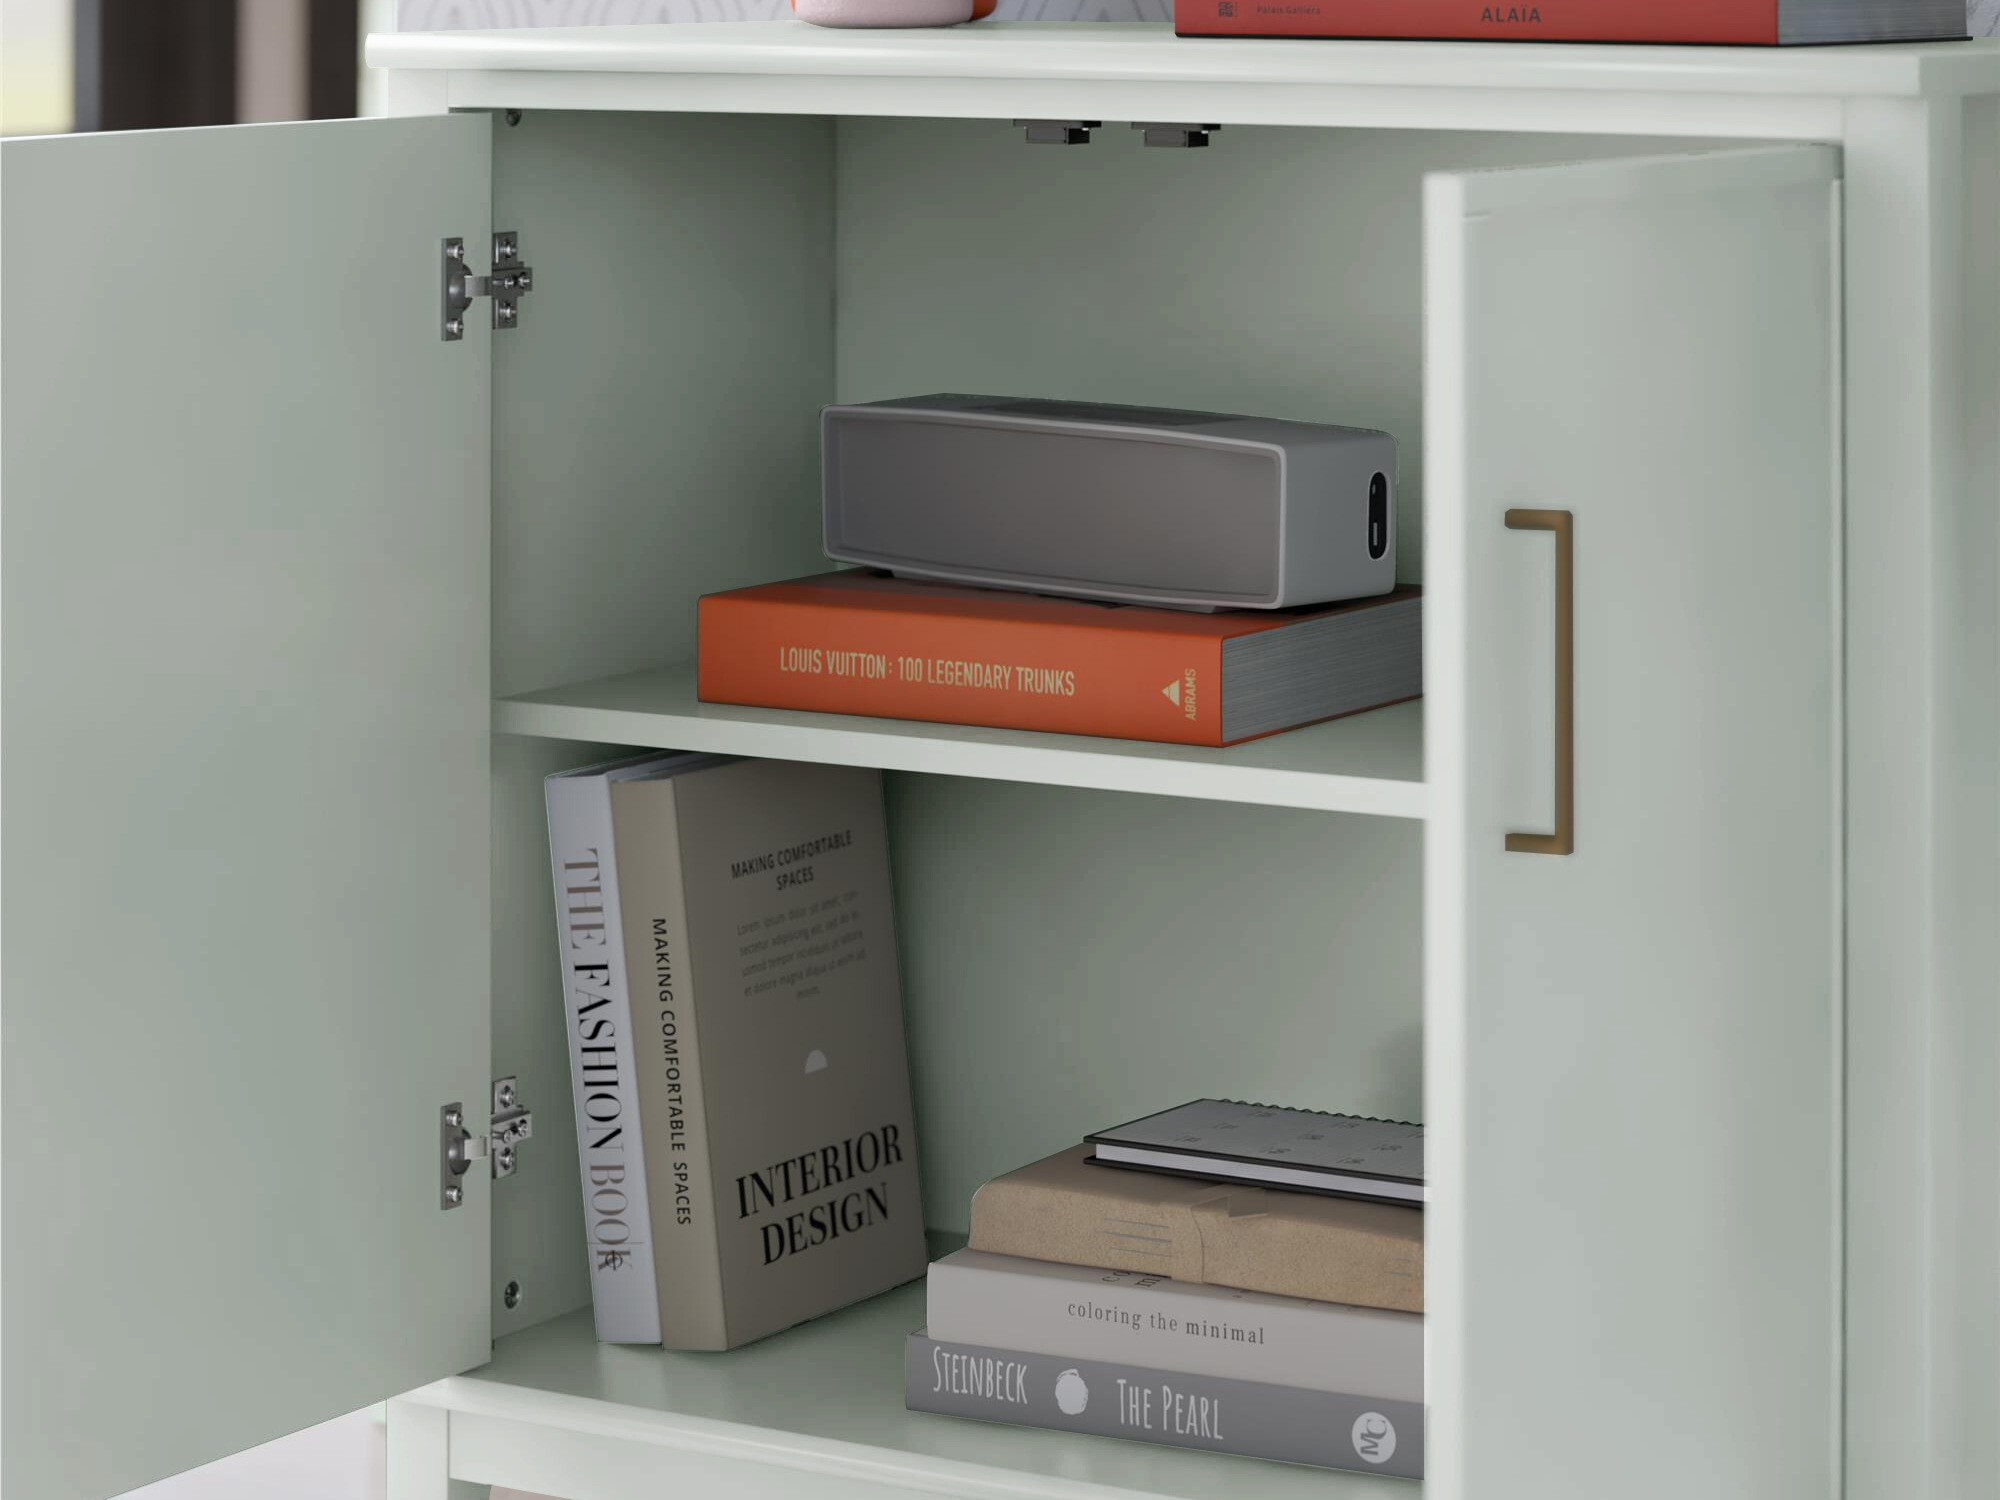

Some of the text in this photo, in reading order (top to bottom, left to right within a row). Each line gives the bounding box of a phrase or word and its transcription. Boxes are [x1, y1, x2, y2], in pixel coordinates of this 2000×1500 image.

[1481, 4, 1542, 22] ALAÏA
[780, 646, 1076, 696] LOUIS VUITTON: 100 LEGENDARY TRUNKS
[1184, 668, 1197, 721] ABRAMS
[731, 829, 853, 880] MAKING COMFORTABLE
[776, 866, 815, 890] SPACES
[564, 847, 633, 1271] THE FASHION BOOK
[652, 918, 692, 1226] MAKING COMFORTABLE SPACES
[735, 1123, 903, 1219] INTERIOR
[760, 1182, 889, 1266] DESIGN
[1068, 1302, 1265, 1344] coloring the minimal
[932, 1345, 1028, 1405] STEINBECK
[1162, 1384, 1224, 1440] PEARL
